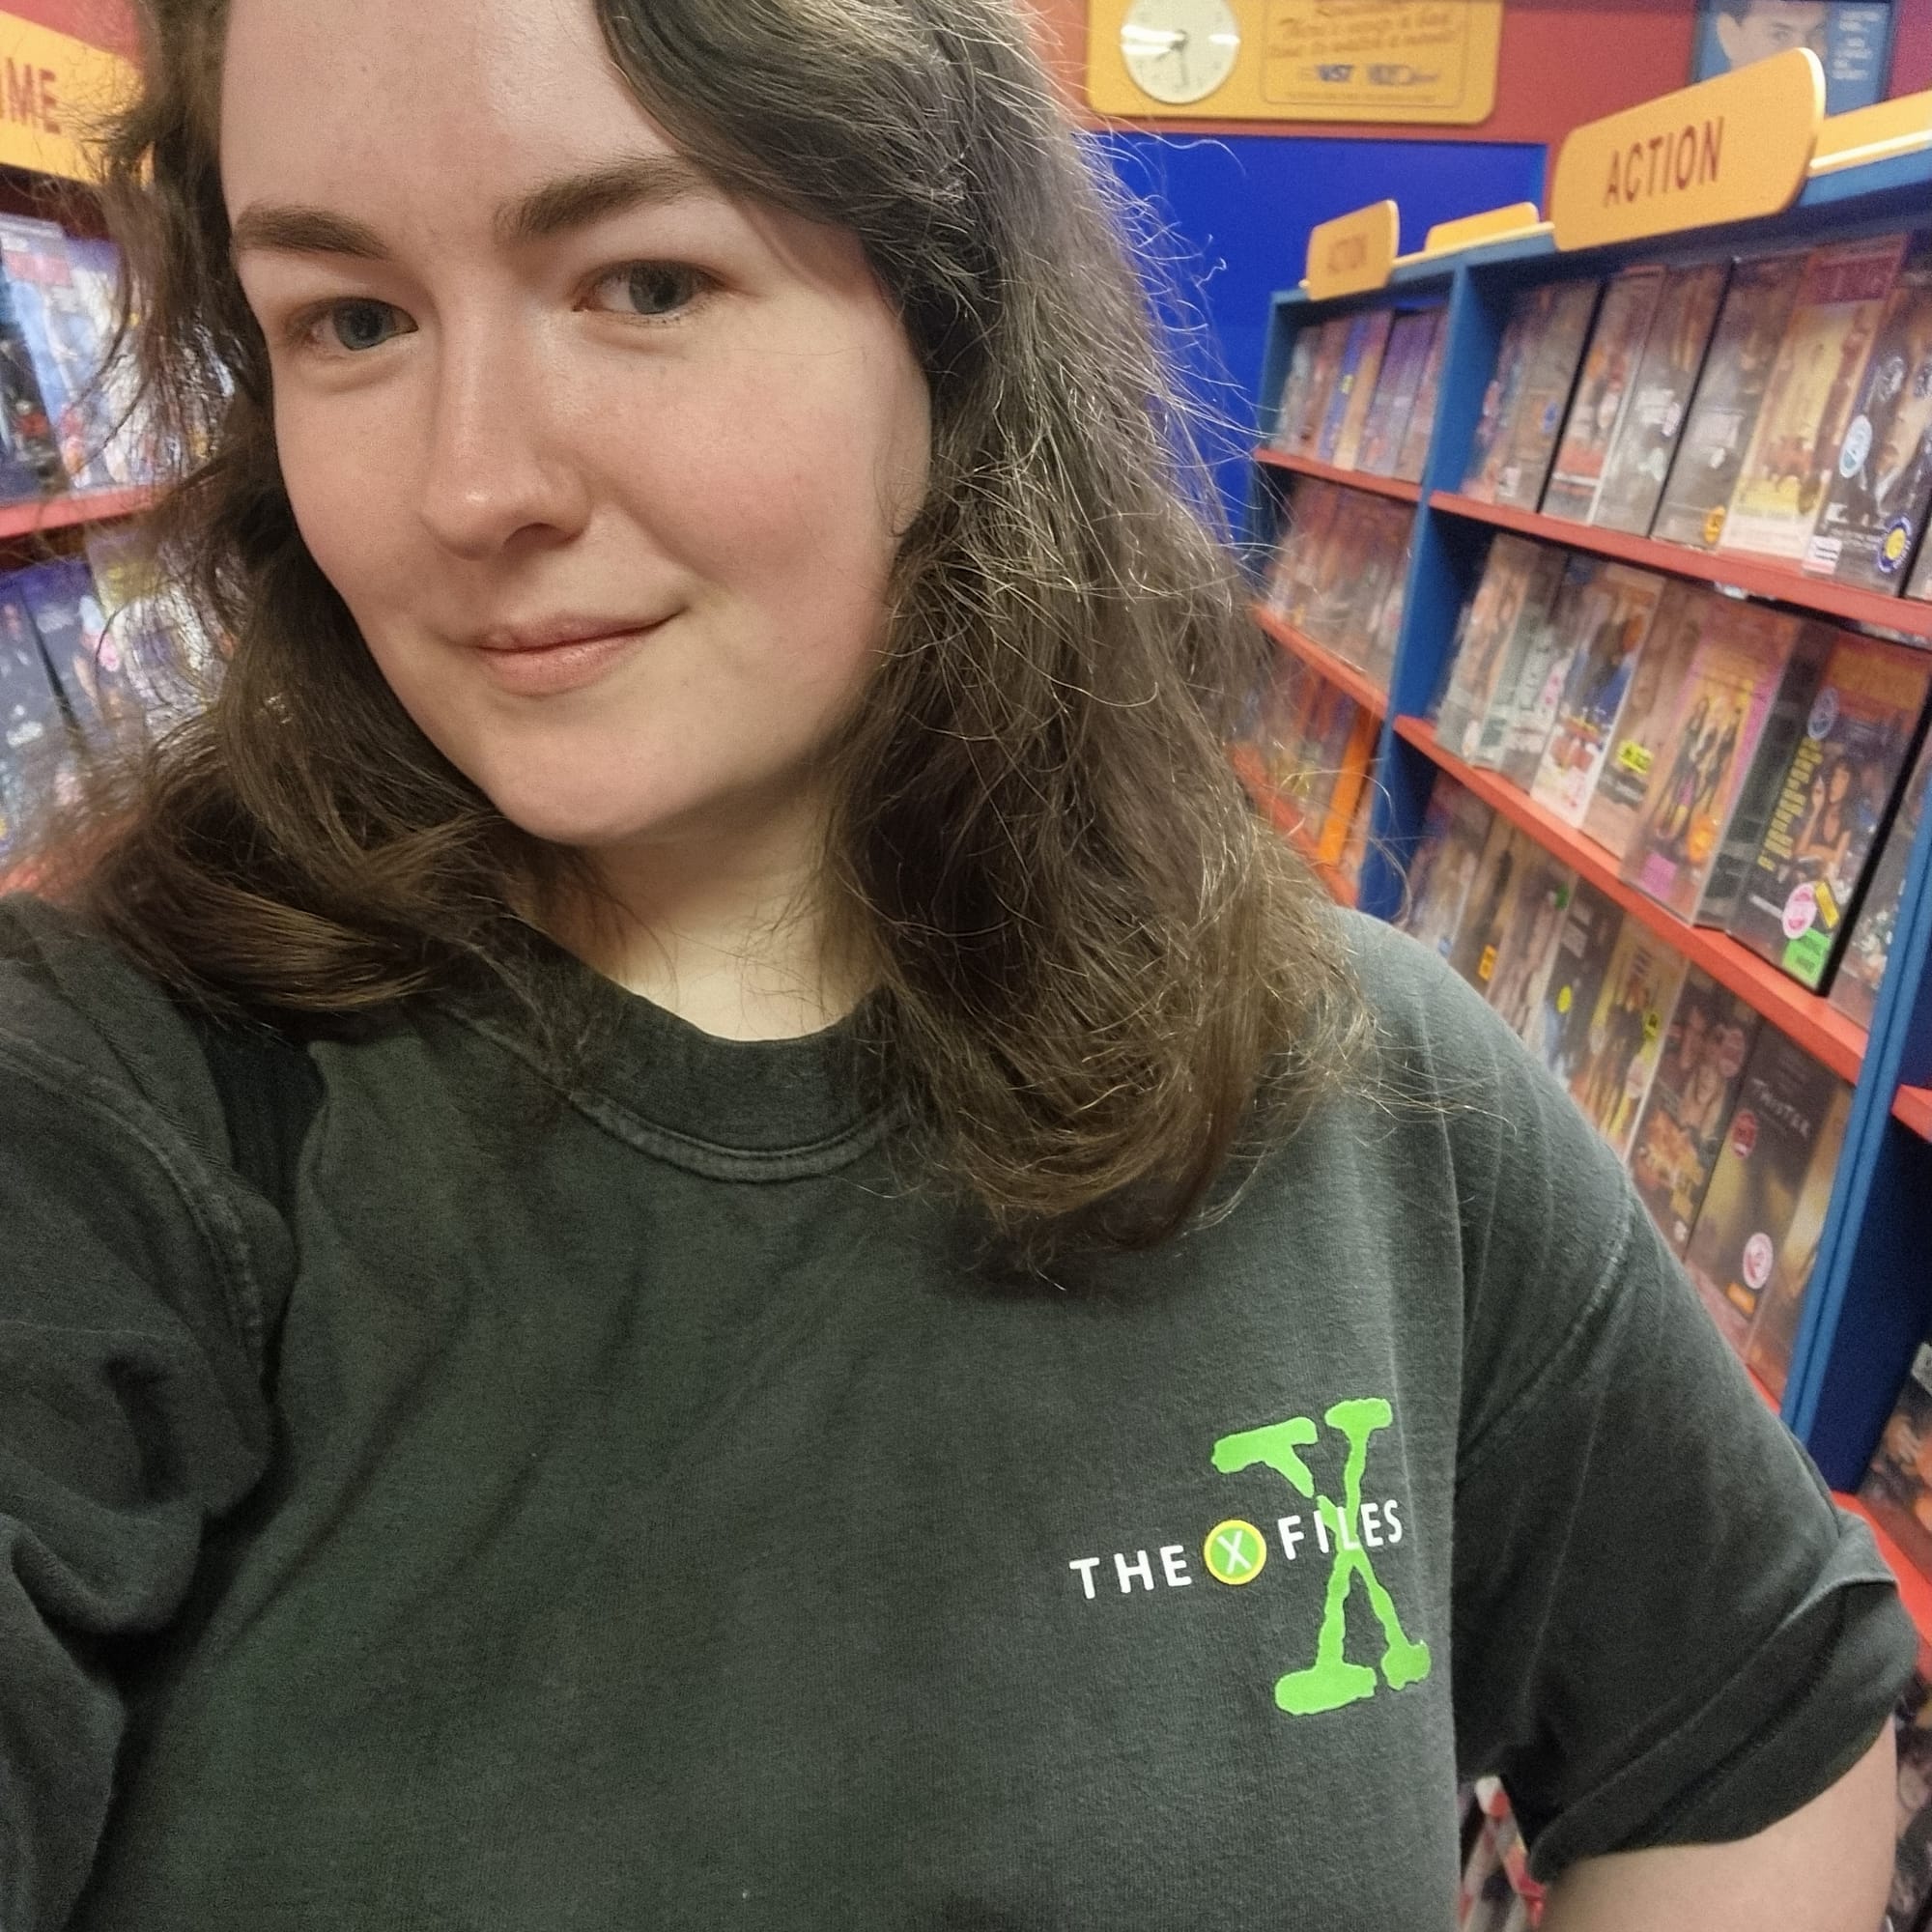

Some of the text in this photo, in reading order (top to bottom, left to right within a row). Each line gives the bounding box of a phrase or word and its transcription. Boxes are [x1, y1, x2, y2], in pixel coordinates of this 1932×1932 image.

[0, 57, 61, 134] ME
[1603, 115, 1725, 208] ACTION
[1068, 1499, 1404, 1600] THE X FILES
